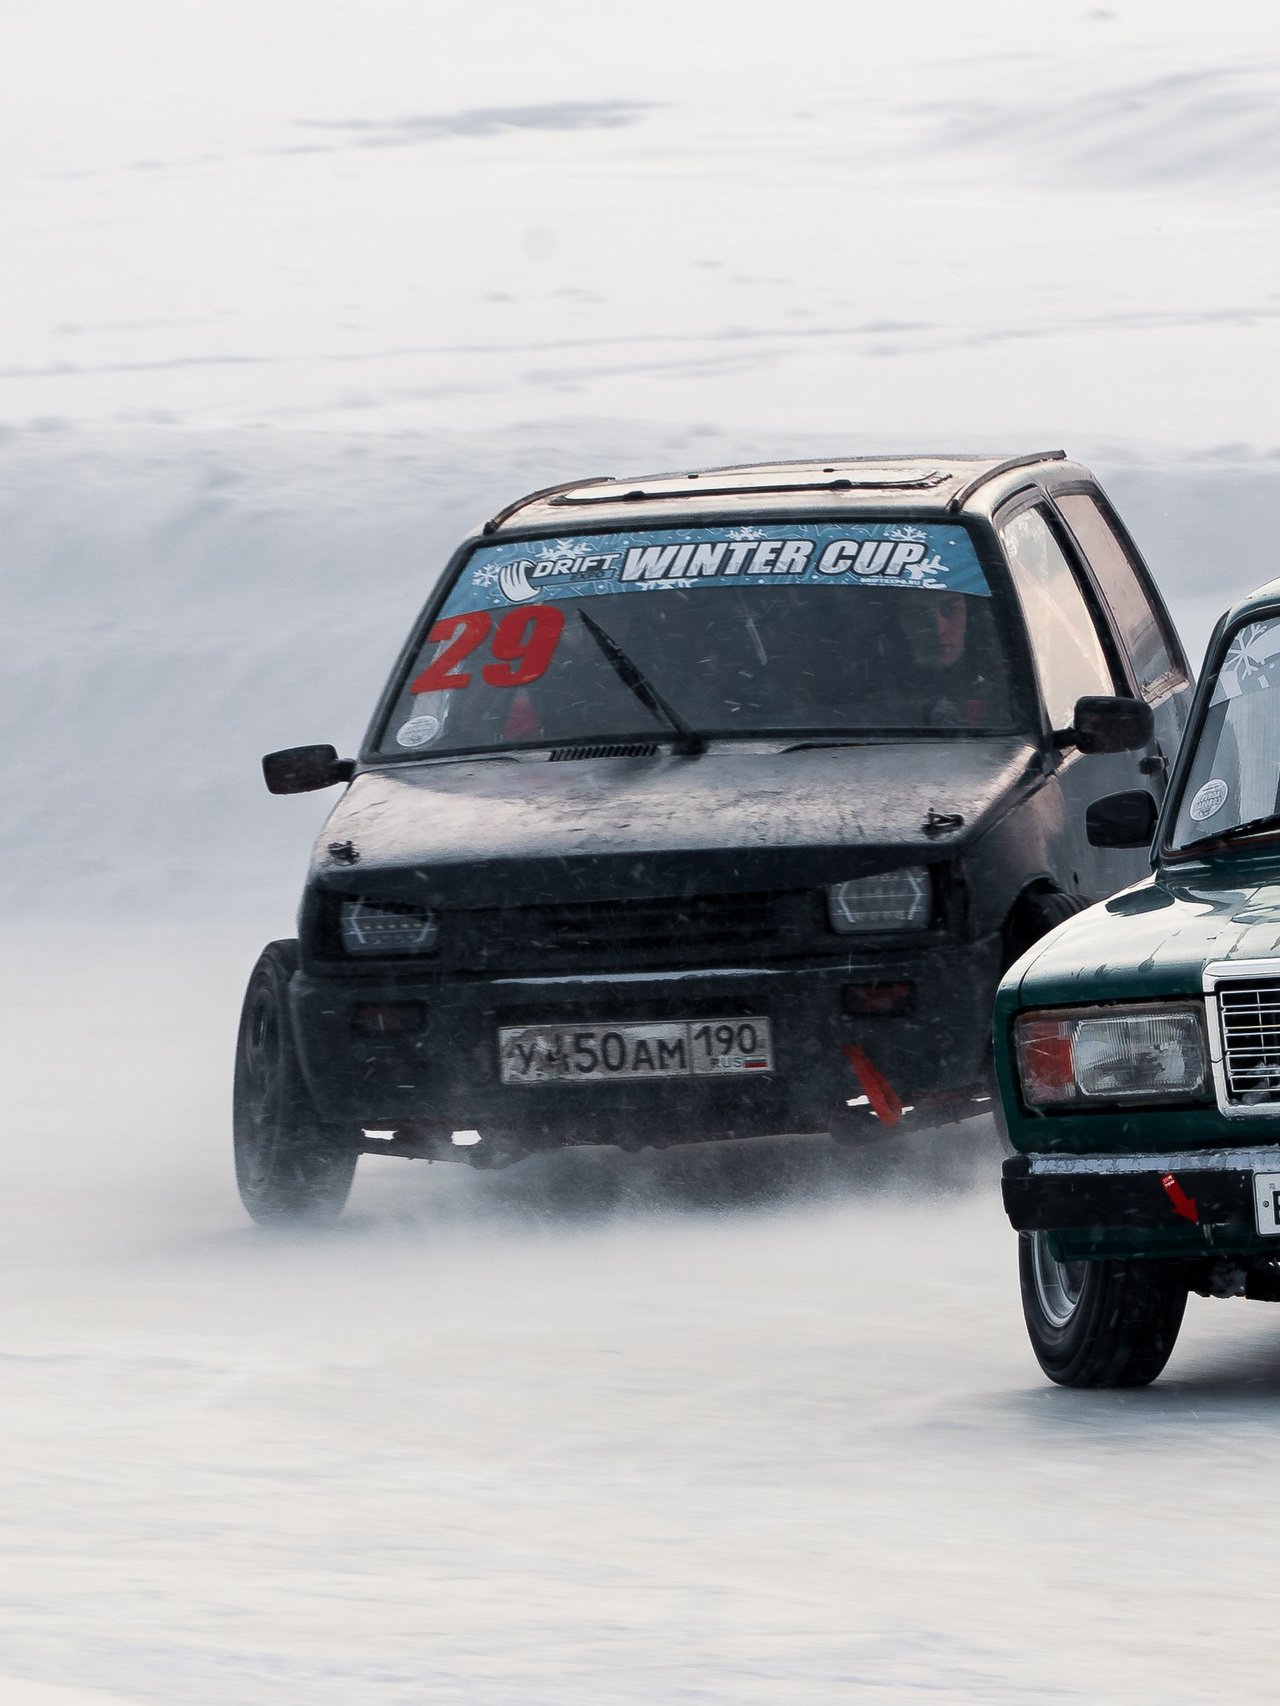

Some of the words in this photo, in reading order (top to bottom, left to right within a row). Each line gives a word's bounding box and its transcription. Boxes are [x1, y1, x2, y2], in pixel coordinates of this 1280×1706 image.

[531, 553, 622, 578] DRIFT
[619, 540, 815, 581] WINTER
[818, 540, 926, 576] CUP
[410, 605, 565, 694] 29
[693, 1023, 758, 1057] 190
[711, 1056, 744, 1069] RUS
